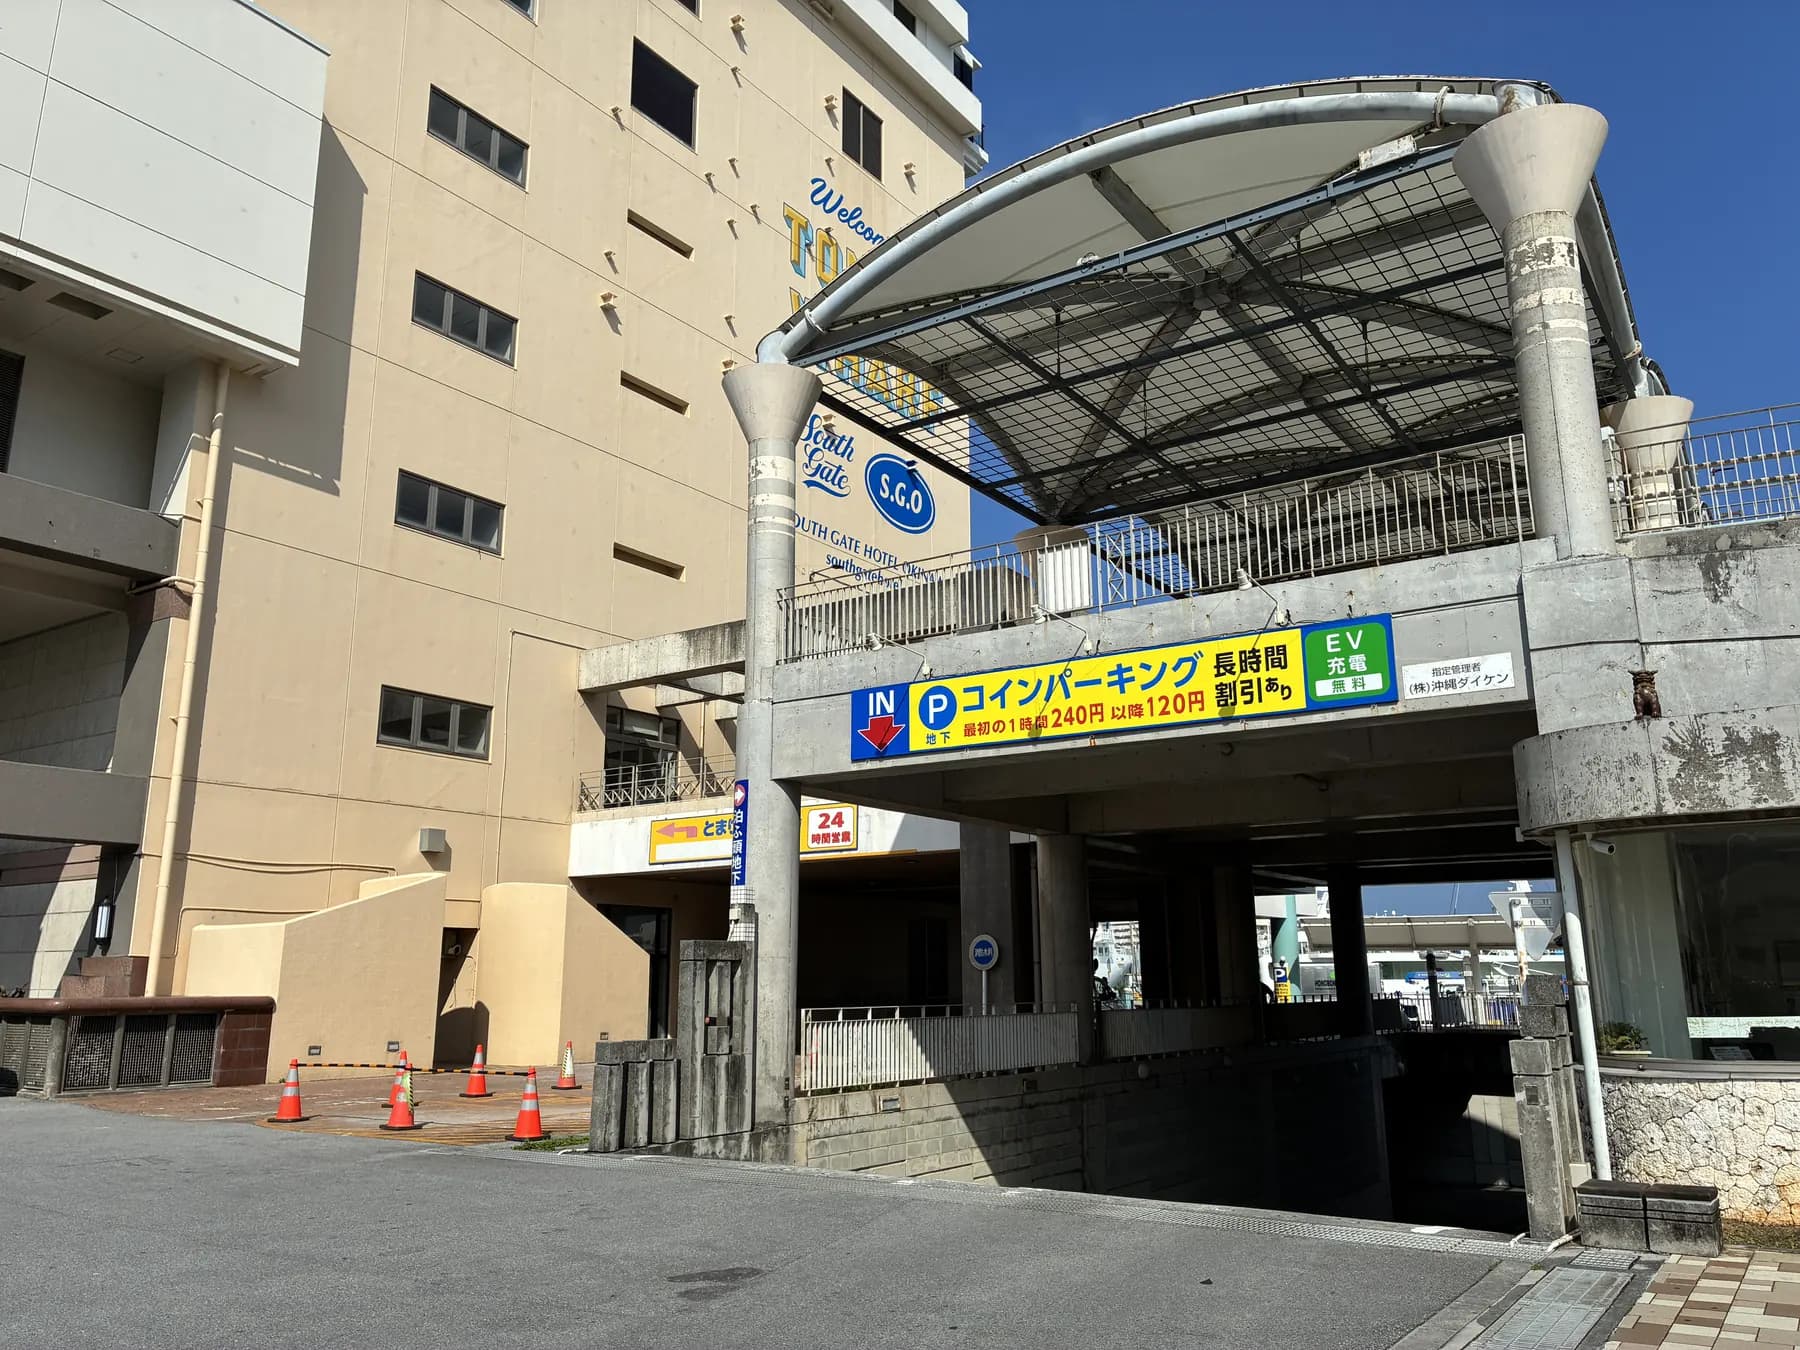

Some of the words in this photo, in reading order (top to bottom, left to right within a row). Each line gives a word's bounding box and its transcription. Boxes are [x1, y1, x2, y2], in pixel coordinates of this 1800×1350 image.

[800, 414, 854, 462] South
[802, 443, 851, 490] Gate
[880, 473, 923, 514] S.G.O
[794, 512, 828, 541] OUTH
[830, 530, 861, 554] GATE
[863, 544, 899, 570] HOTEL
[1326, 630, 1364, 653] EV
[1214, 644, 1288, 678] 長時間
[1327, 653, 1368, 676] 充電
[1431, 661, 1482, 678] 指定管理者
[962, 651, 1204, 712] コインパーキング
[1215, 677, 1292, 707] 割引あり
[1331, 676, 1367, 694] 無料
[868, 690, 895, 716] IN
[928, 693, 948, 725] P
[926, 731, 951, 745] 地下
[818, 811, 845, 829] 24
[811, 831, 851, 845] 時間営業
